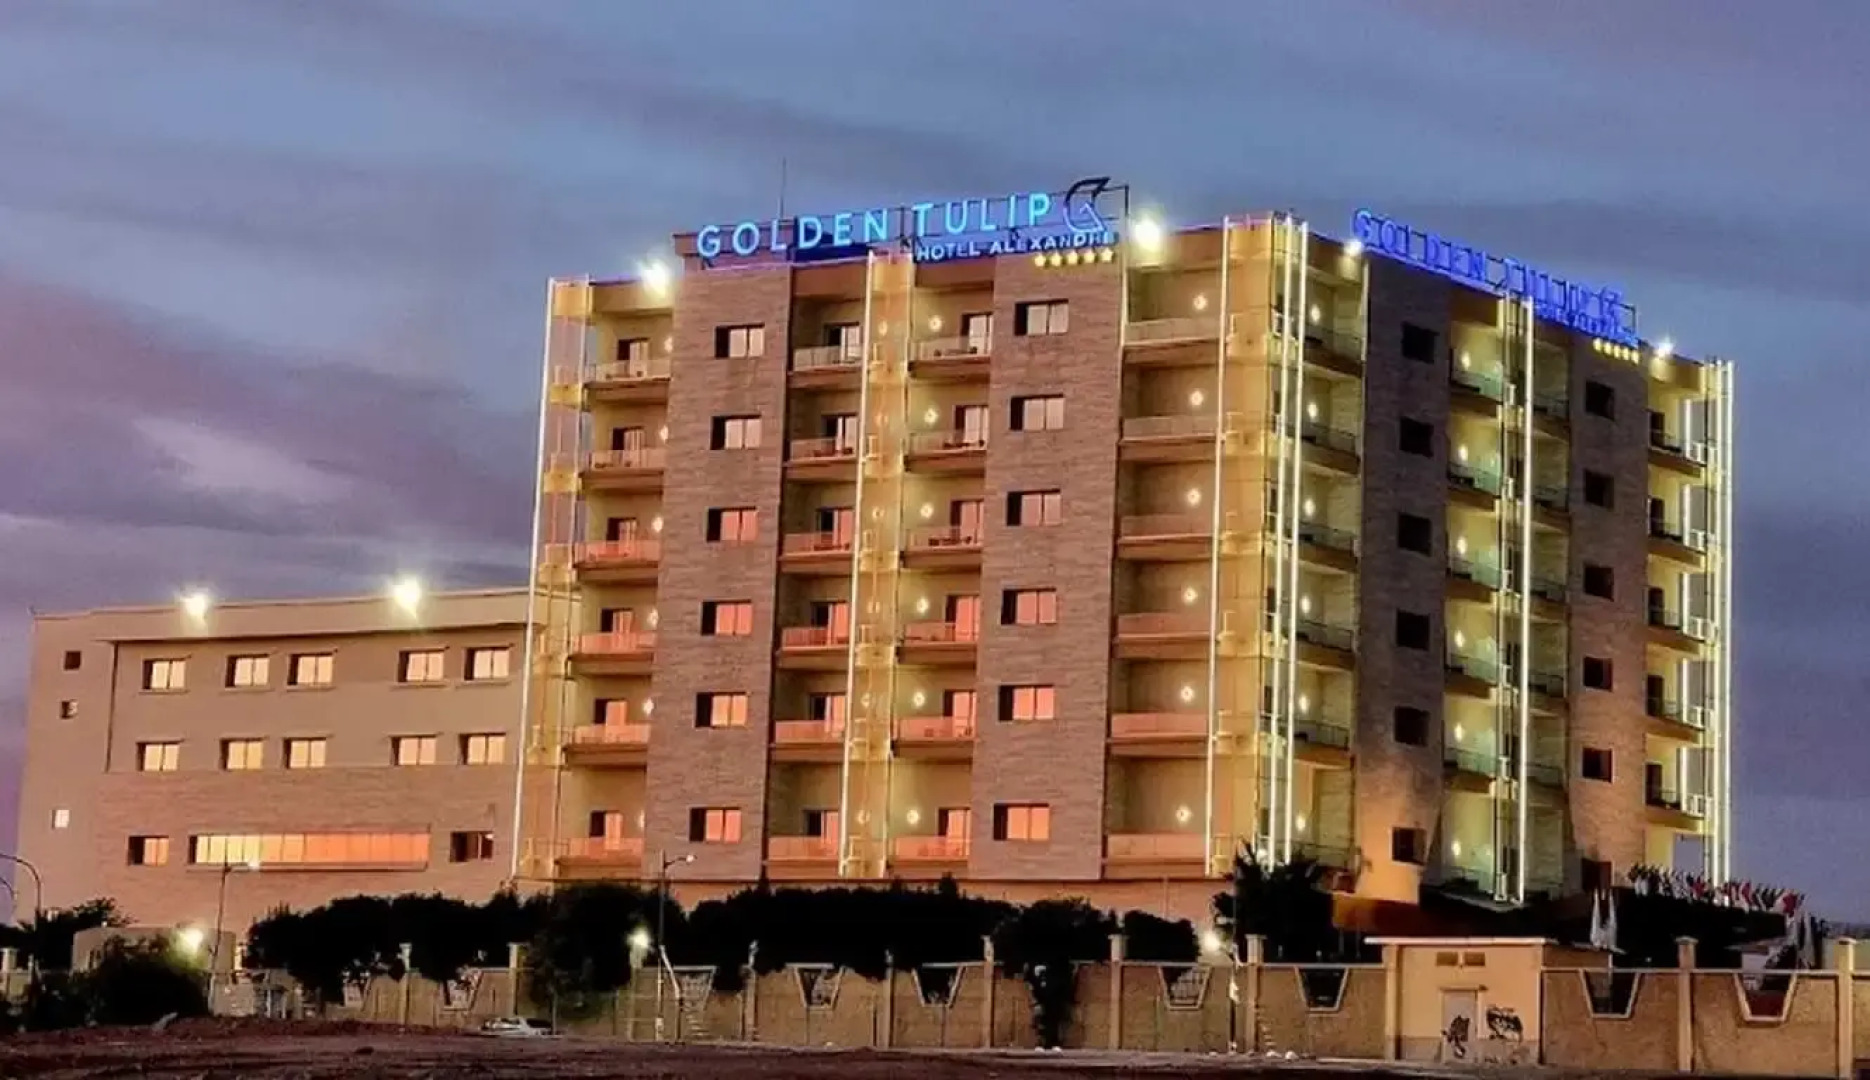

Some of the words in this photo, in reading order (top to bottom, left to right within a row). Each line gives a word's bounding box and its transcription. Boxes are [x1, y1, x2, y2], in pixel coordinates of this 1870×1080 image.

[697, 208, 888, 258] GOLDEN
[911, 193, 1051, 237] TULIP
[1354, 208, 1486, 282] GOLDEN
